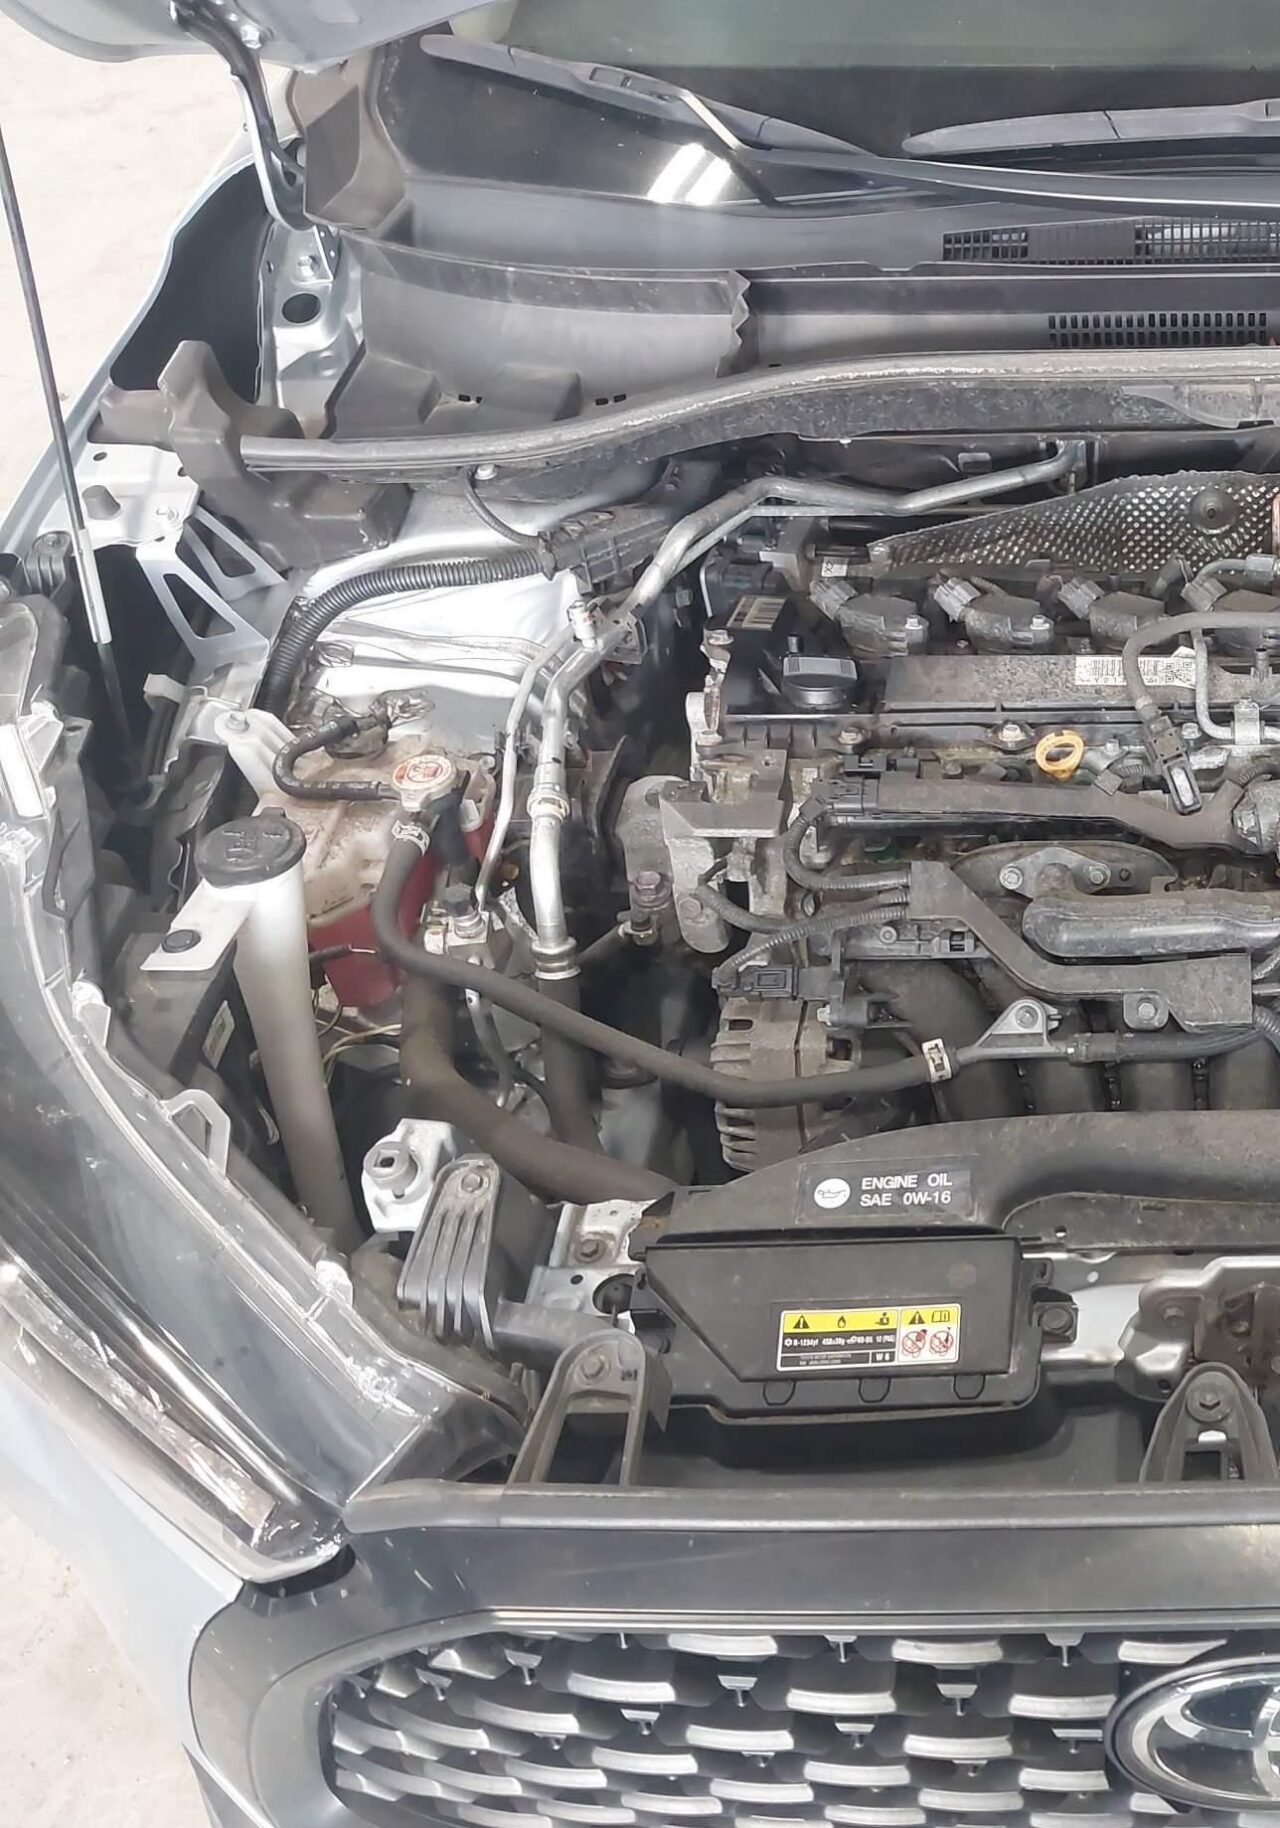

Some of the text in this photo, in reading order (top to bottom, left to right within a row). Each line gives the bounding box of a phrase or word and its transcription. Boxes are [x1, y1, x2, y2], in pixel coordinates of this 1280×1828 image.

[861, 1173, 952, 1191] ENGINE OIL
[860, 1191, 951, 1207] SAE 0W-16
